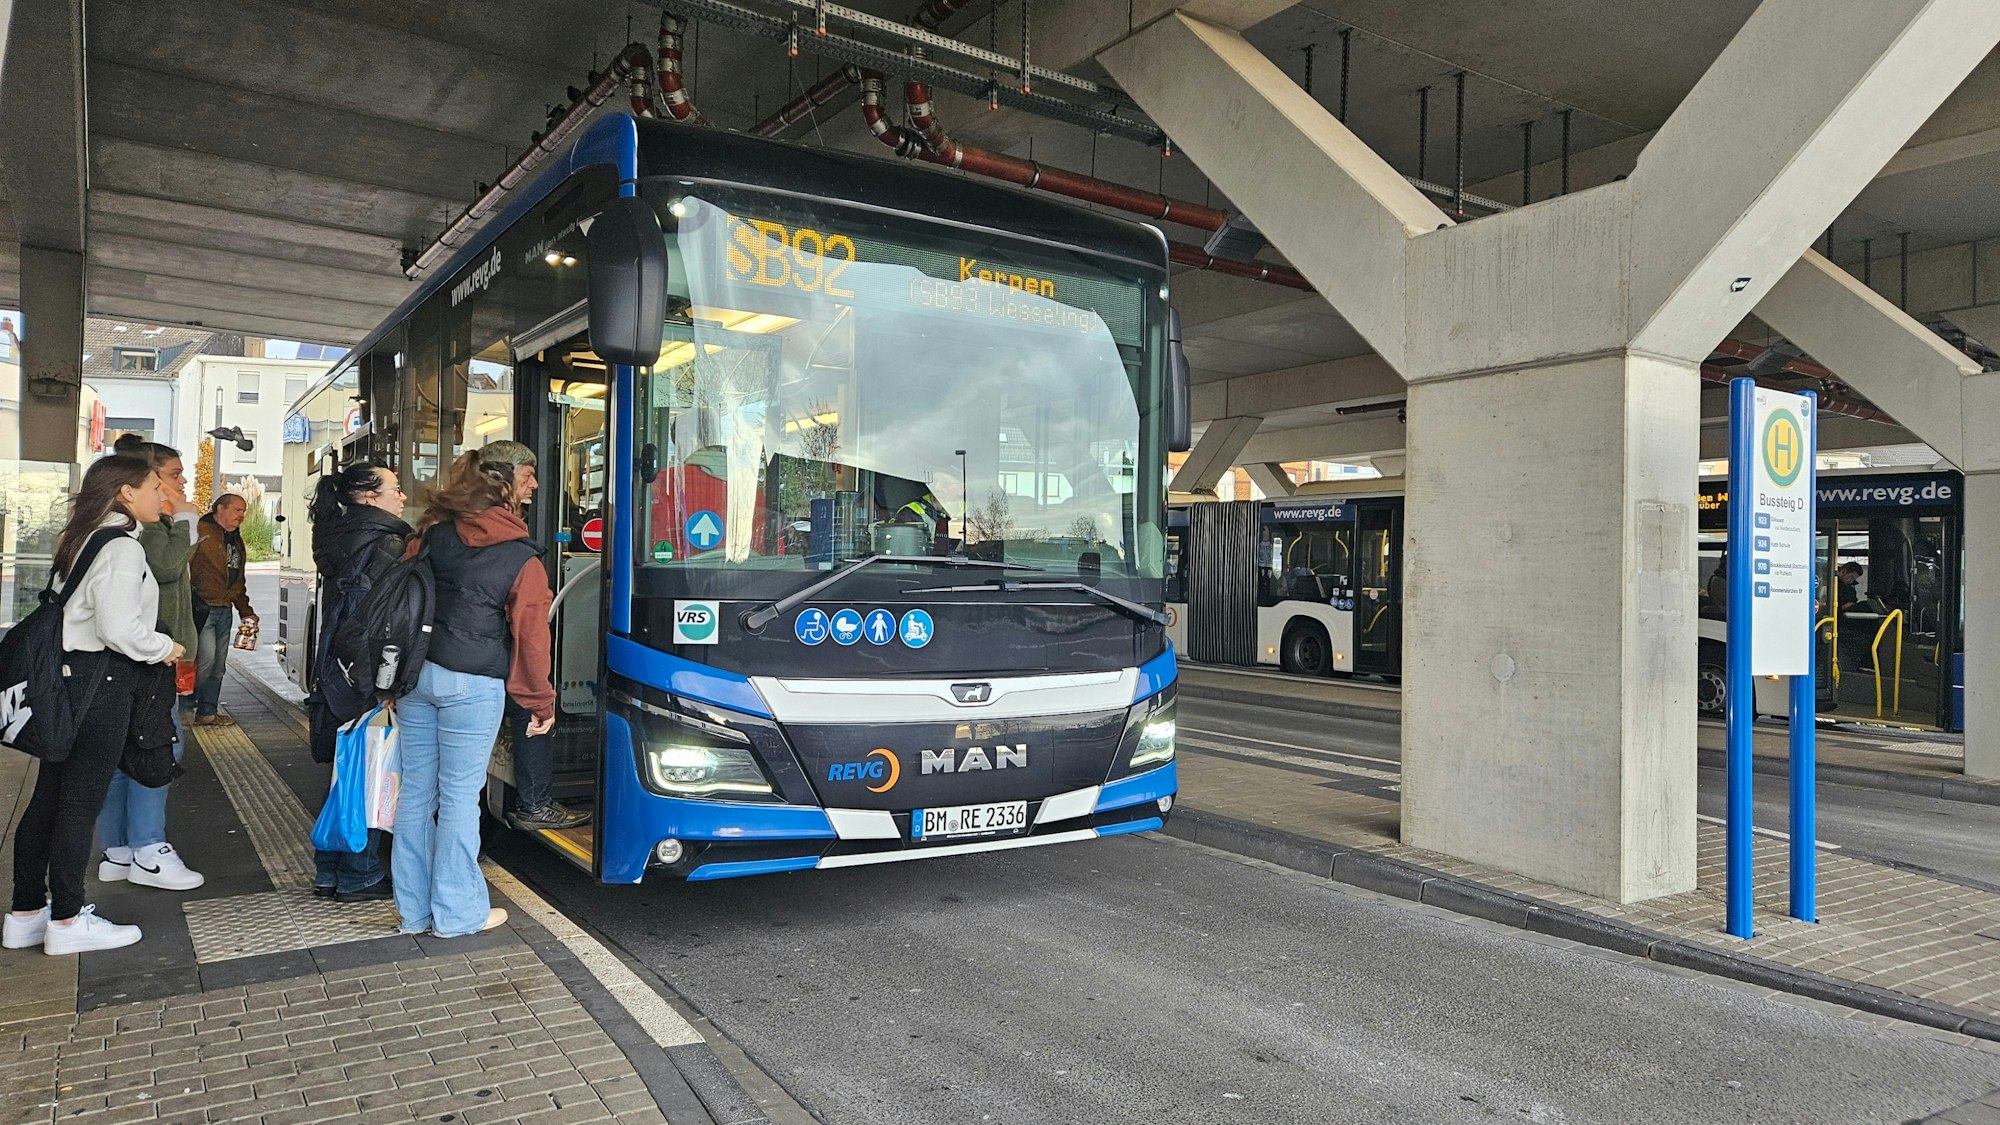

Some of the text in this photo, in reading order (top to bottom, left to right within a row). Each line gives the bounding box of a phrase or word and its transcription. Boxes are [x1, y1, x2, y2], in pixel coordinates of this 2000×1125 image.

[727, 215, 855, 298] SB92
[451, 246, 501, 307] www.revg.de
[960, 256, 1054, 298] Kerpen
[1760, 493, 1804, 513] Bussteig D
[1816, 481, 1952, 505] ww.revg.de
[1273, 505, 1342, 521] www.revg.de
[1699, 501, 1721, 510] über
[659, 541, 667, 552] 4
[1757, 539, 1767, 548] 924
[1757, 585, 1767, 594] 971
[677, 611, 707, 624] VRS
[920, 743, 1027, 775] MAN
[828, 760, 884, 782] REVG
[925, 804, 1024, 832] BM RE 2336
